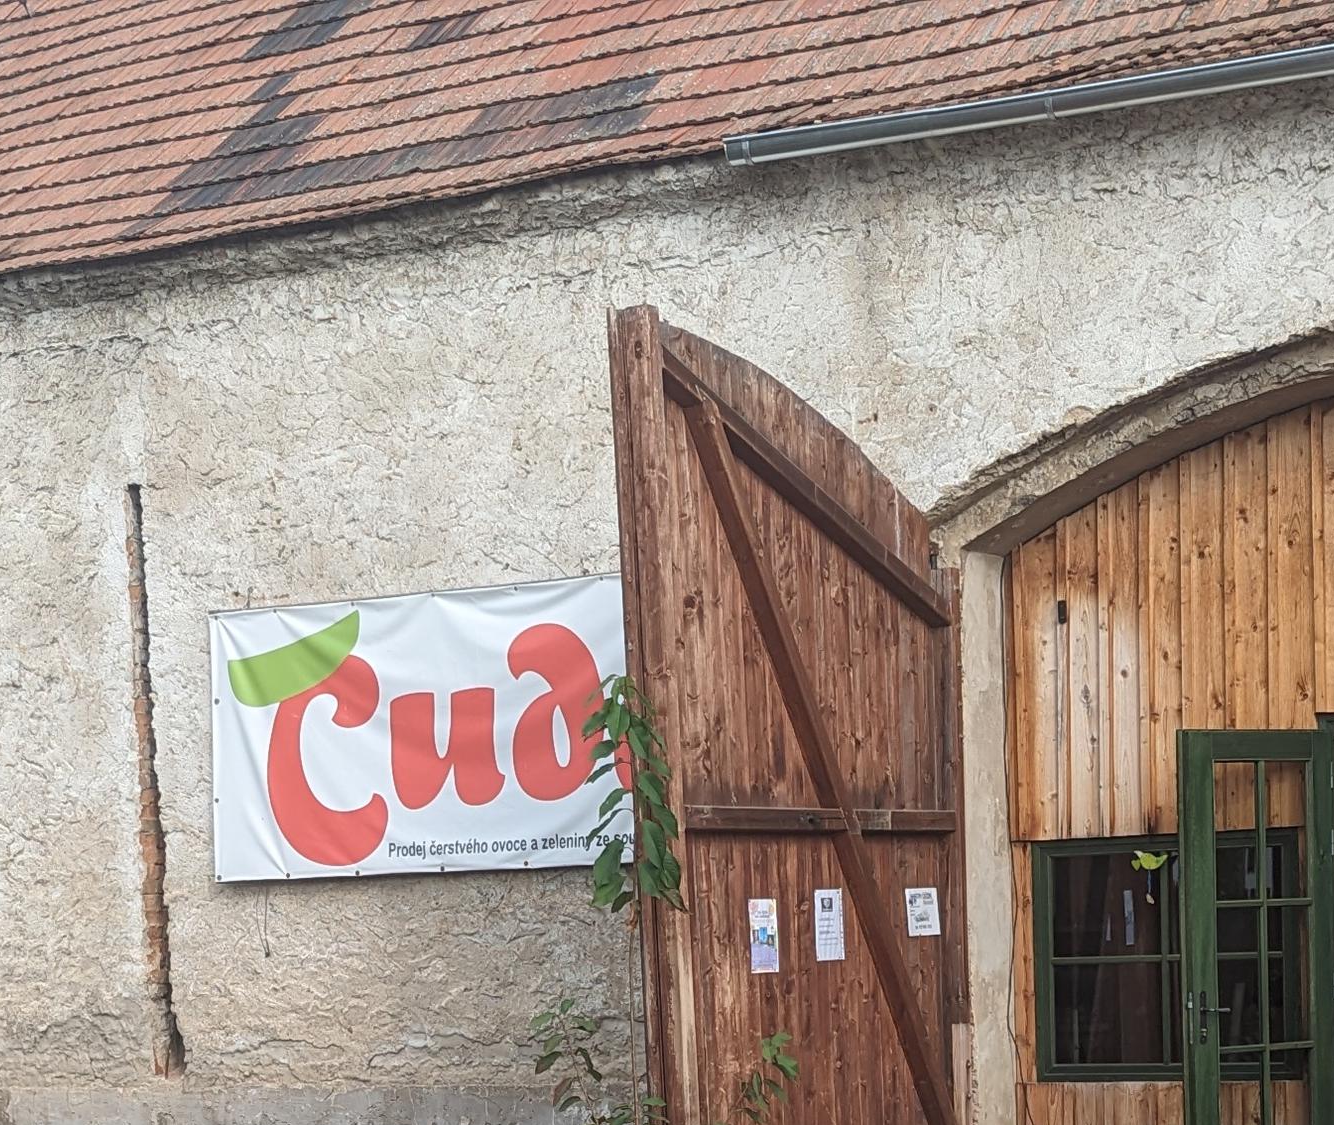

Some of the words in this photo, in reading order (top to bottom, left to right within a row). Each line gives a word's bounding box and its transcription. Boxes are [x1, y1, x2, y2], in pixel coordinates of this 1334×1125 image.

[388, 842, 426, 860] Prodej
[430, 838, 489, 858] čerstvého
[491, 837, 528, 852] ovoce
[530, 837, 539, 851] a
[541, 833, 593, 852] zeleniny
[596, 834, 611, 847] ze
